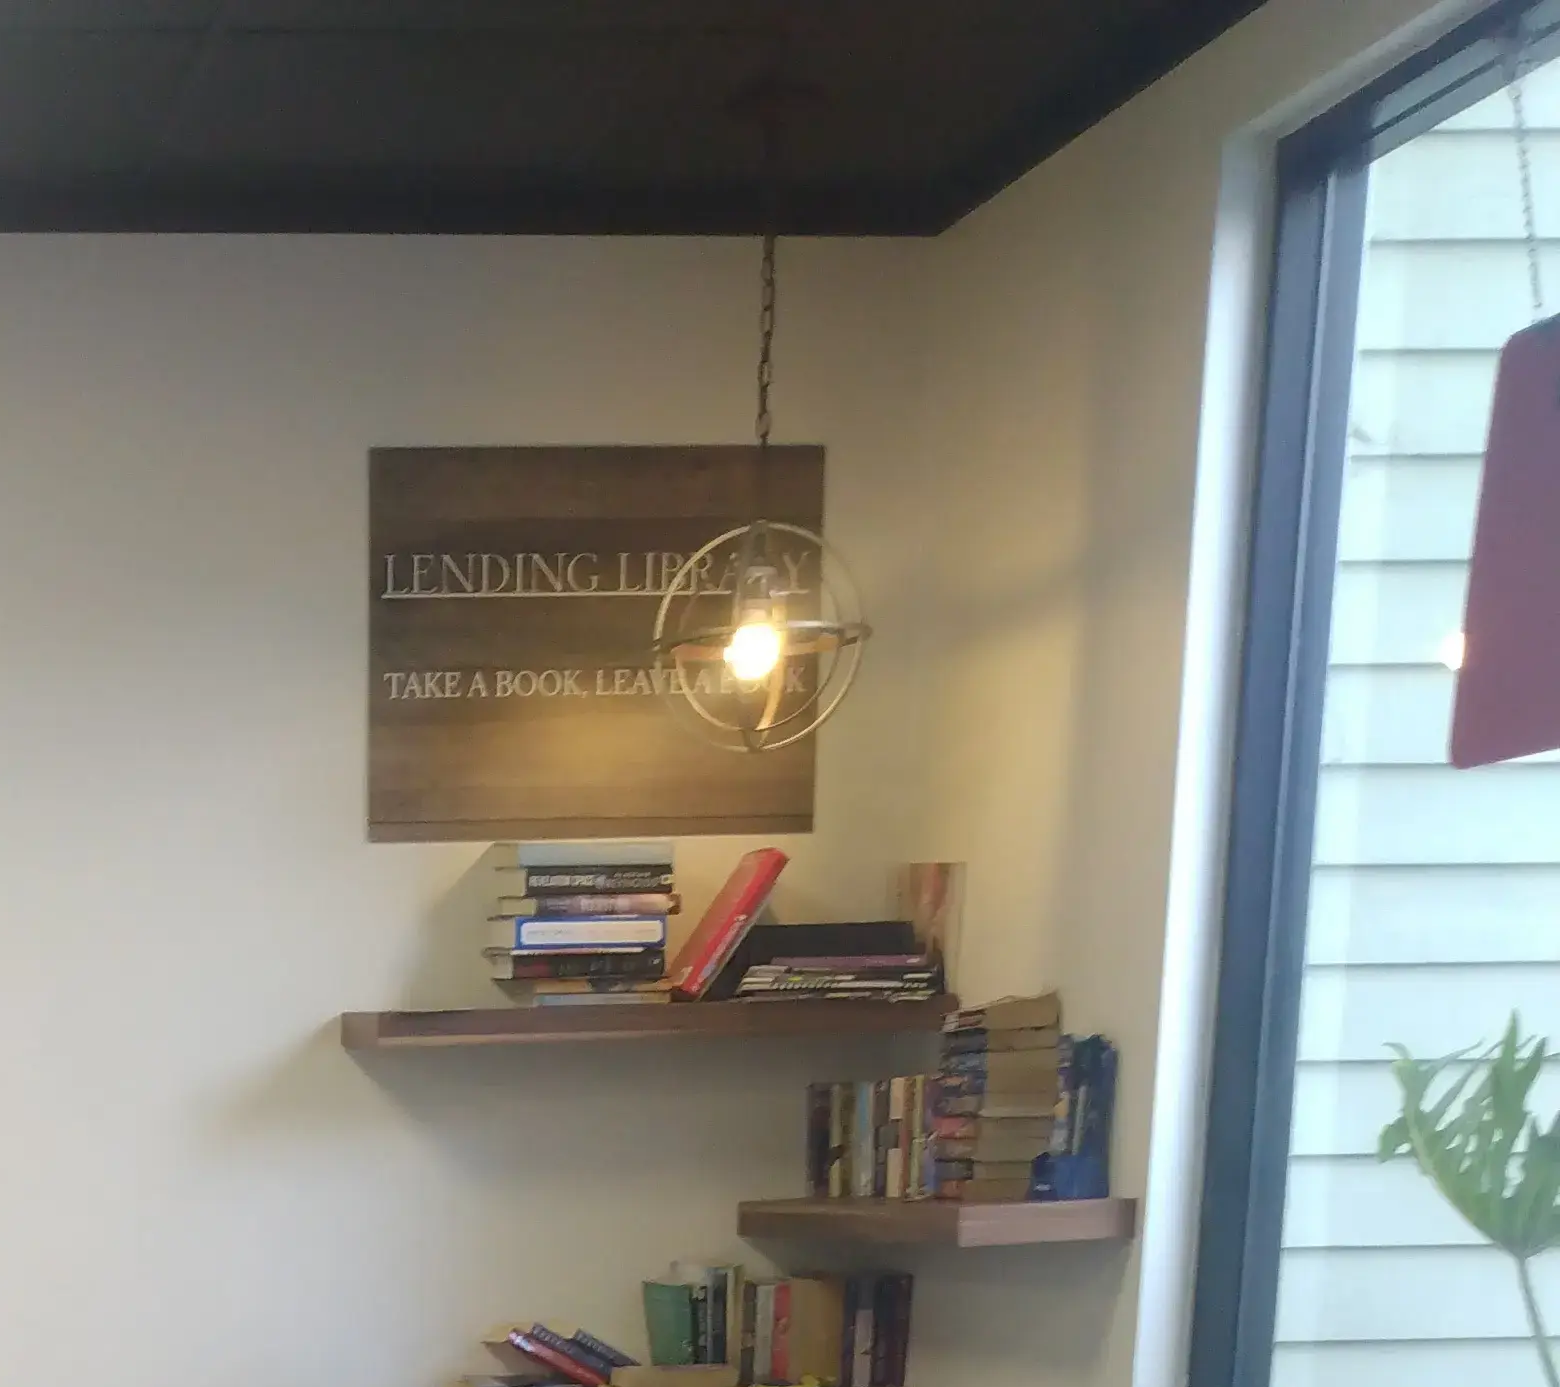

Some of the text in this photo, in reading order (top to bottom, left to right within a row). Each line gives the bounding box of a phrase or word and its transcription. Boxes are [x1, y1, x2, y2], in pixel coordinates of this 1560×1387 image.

[383, 550, 810, 594] LENDING LIBRAY
[383, 666, 808, 699] TAKE A BOOK, LEAVE A BK
